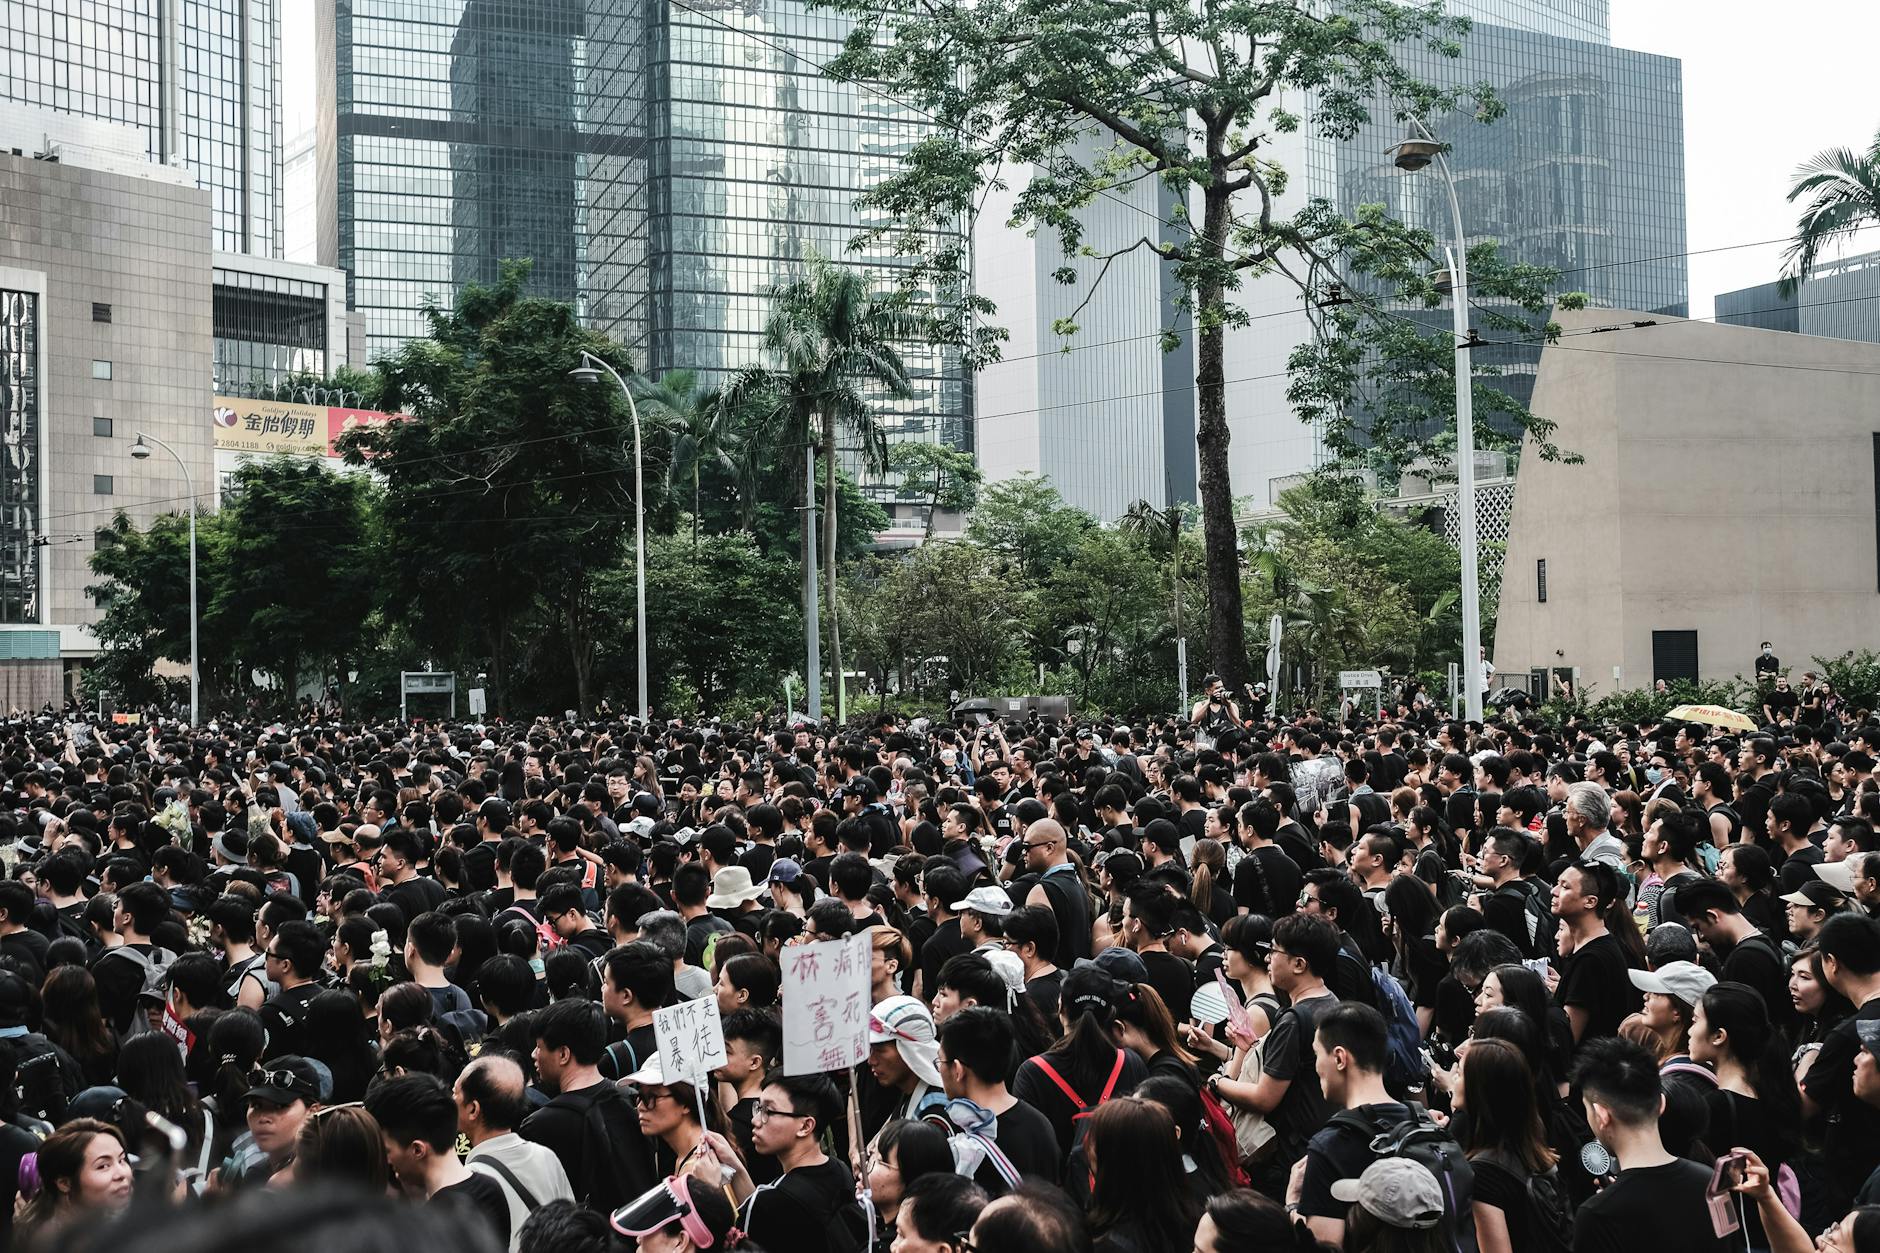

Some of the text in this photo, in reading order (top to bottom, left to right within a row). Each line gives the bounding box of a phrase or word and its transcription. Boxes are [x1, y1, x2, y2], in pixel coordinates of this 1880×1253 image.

[242, 411, 315, 440] 金怡假期
[221, 439, 259, 450] 2804 1188
[658, 998, 716, 1034] 我們不是
[670, 1024, 720, 1072] 暴徒
